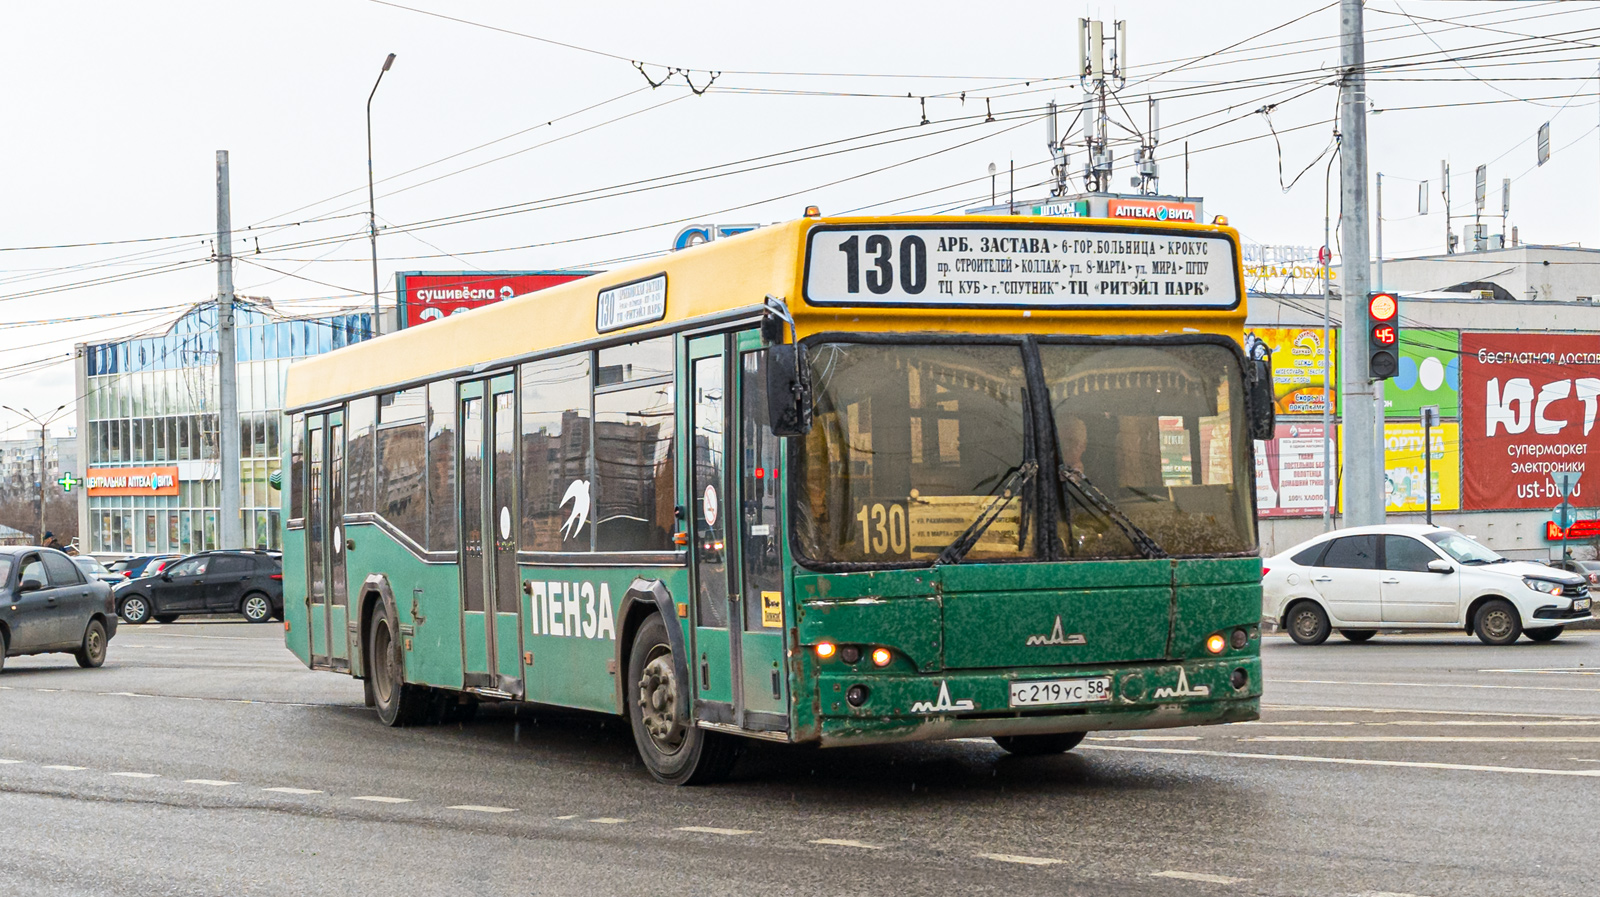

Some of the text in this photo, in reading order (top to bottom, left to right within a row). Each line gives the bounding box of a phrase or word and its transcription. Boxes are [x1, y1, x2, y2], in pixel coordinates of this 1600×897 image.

[1040, 202, 1076, 216] ШТОРЫ
[1115, 205, 1194, 220] АПТЕКА ВИТА
[937, 236, 973, 253] АРБ.
[980, 237, 1050, 254] ЗАСТАВА
[1167, 241, 1208, 255] КРОКУС
[838, 233, 927, 295] 130
[937, 261, 951, 277] пр.
[955, 257, 1012, 273] СТРОИТЕЛЕЙ
[1021, 259, 1061, 273] КОЛЛАЖ
[1086, 260, 1126, 274] 8-МАРТА
[1152, 261, 1177, 274] МИРА
[1185, 261, 1209, 275] ПГПУ
[416, 286, 496, 304] сушивёсла
[938, 280, 953, 296] ТЦ
[958, 280, 980, 294] КУБ
[1068, 280, 1088, 296] ТЦ
[1094, 279, 1159, 295] «РИТЭЙЛ
[1165, 281, 1210, 295] ПАРК»
[600, 291, 616, 327] 130
[1375, 328, 1395, 343] 45
[1478, 348, 1555, 364] бесплатная
[1486, 377, 1600, 437] ЮСТ
[1507, 443, 1588, 458] супермаркет
[1511, 462, 1586, 475] электроники
[86, 475, 173, 490] ЦЕНТРАЛЬНАЯ АПТЕКА ВИТА
[856, 503, 907, 554] 130
[531, 581, 616, 640] ПЕНЗА
[1088, 681, 1104, 694] 58
